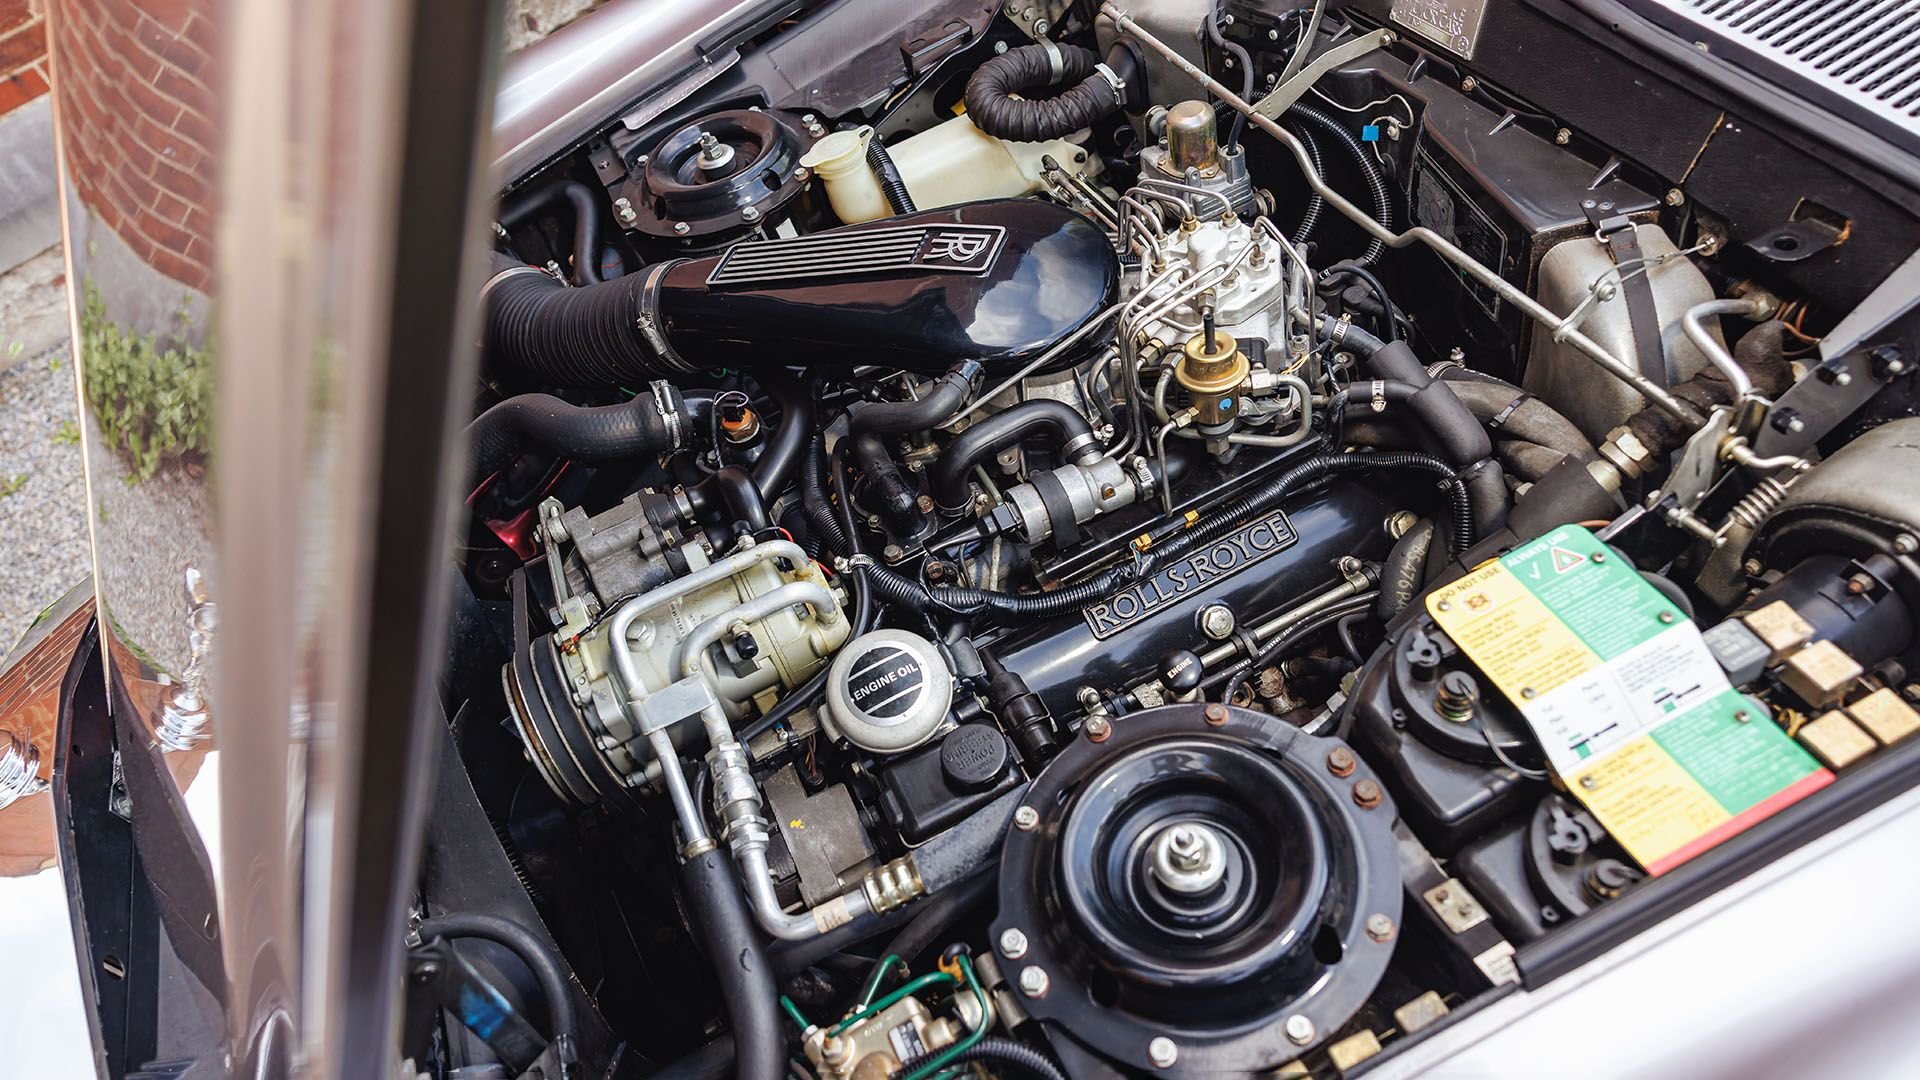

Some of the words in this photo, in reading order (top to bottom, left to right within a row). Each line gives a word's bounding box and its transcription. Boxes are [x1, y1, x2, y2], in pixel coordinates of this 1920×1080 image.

[1506, 542, 1549, 567] ALWAYS
[1090, 516, 1291, 632] ROLLS-ROYCE
[1440, 589, 1456, 600] DO
[1457, 577, 1479, 591] NOT
[1480, 566, 1500, 580] USE
[853, 671, 898, 702] ENGINE
[897, 663, 919, 678] OIL
[1166, 657, 1193, 680] ENGINE
[944, 731, 995, 763] STEERING
[959, 744, 995, 770] POWER
